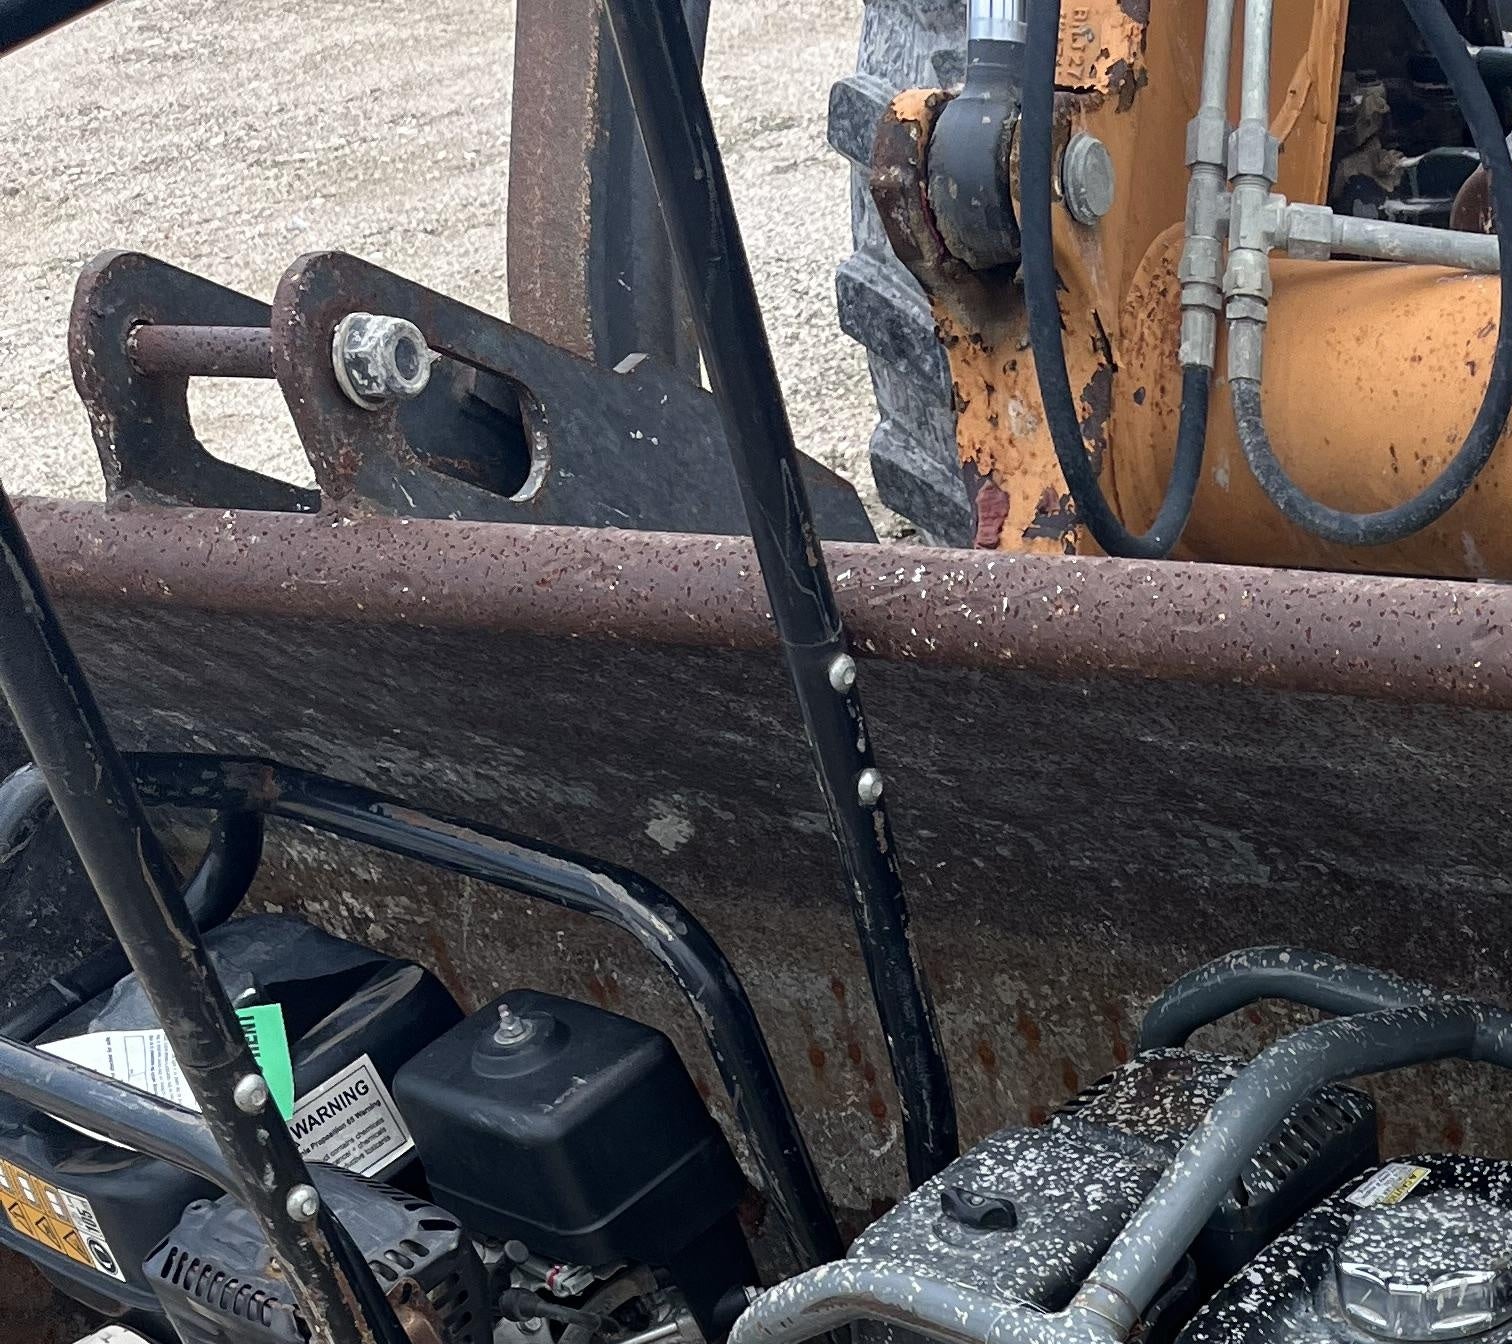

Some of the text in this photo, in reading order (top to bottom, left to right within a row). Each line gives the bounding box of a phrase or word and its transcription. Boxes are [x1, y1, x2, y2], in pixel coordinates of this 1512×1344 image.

[289, 1080, 369, 1139] WARNING
[354, 1100, 381, 1119] Warning
[77, 1206, 99, 1234] 105
